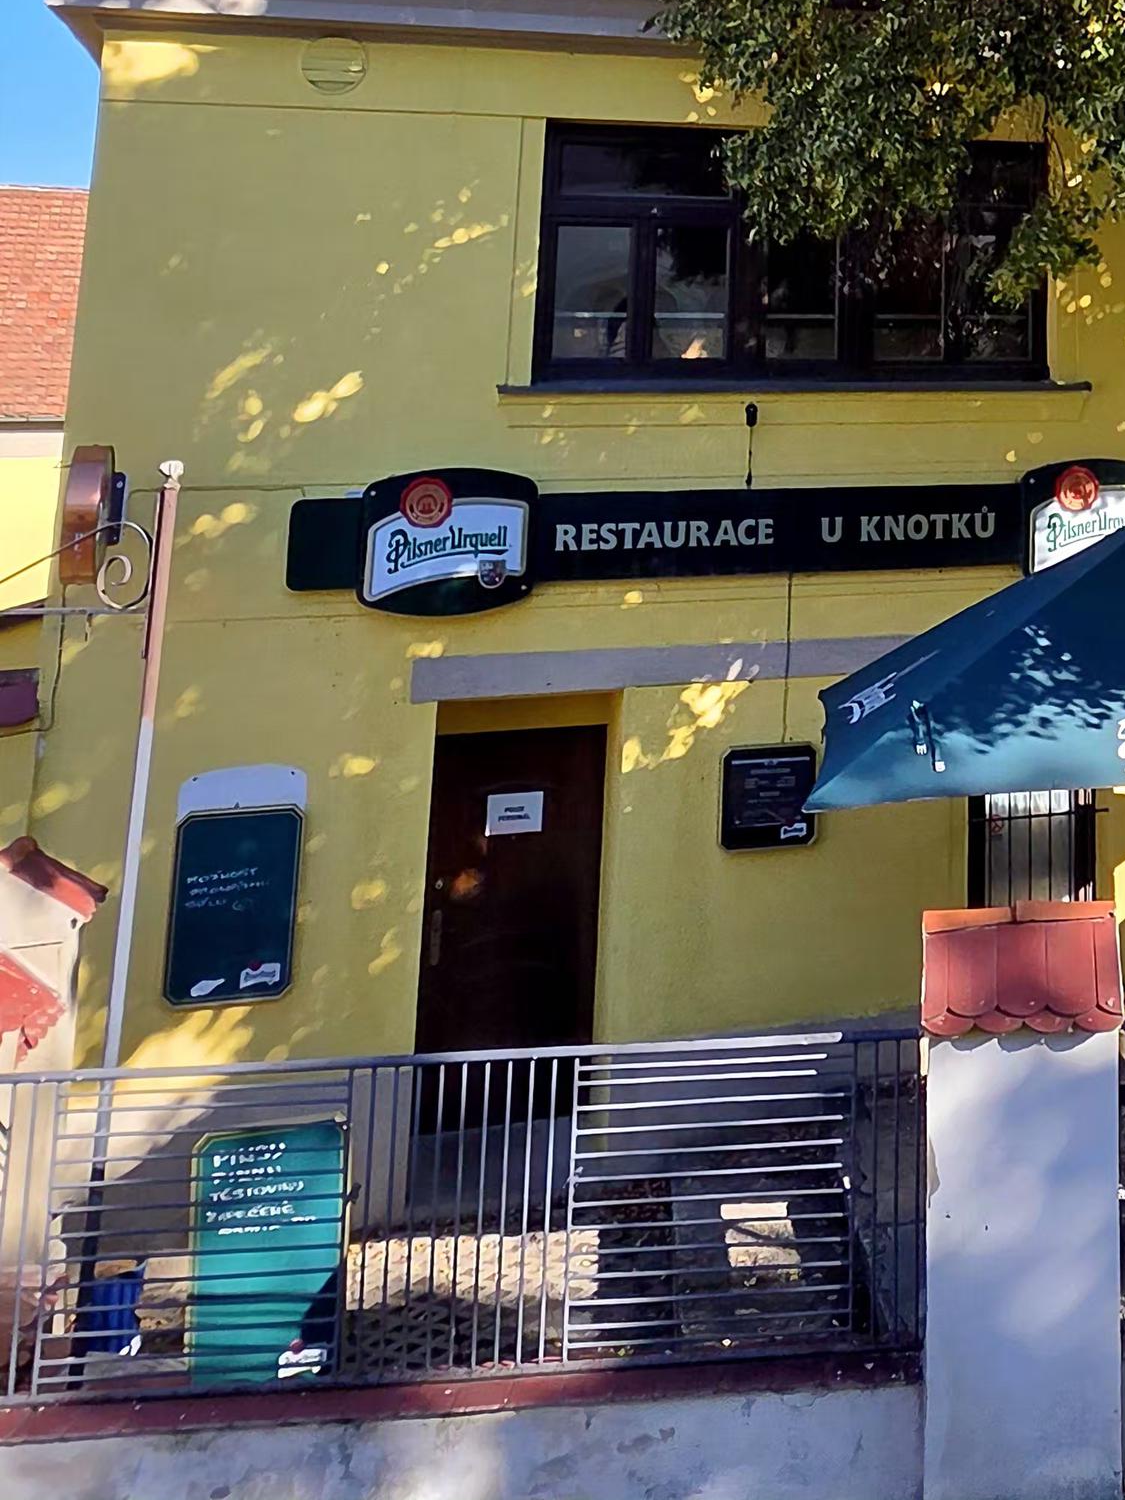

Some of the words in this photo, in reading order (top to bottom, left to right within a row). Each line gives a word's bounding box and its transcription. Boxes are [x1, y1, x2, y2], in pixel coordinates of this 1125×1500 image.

[385, 528, 450, 575] Pilsner
[449, 525, 508, 559] Urquell
[554, 518, 775, 552] RESTAURACE
[821, 516, 843, 543] U
[860, 505, 996, 542] KNOTKŮ
[1046, 512, 1098, 553] Pilsner
